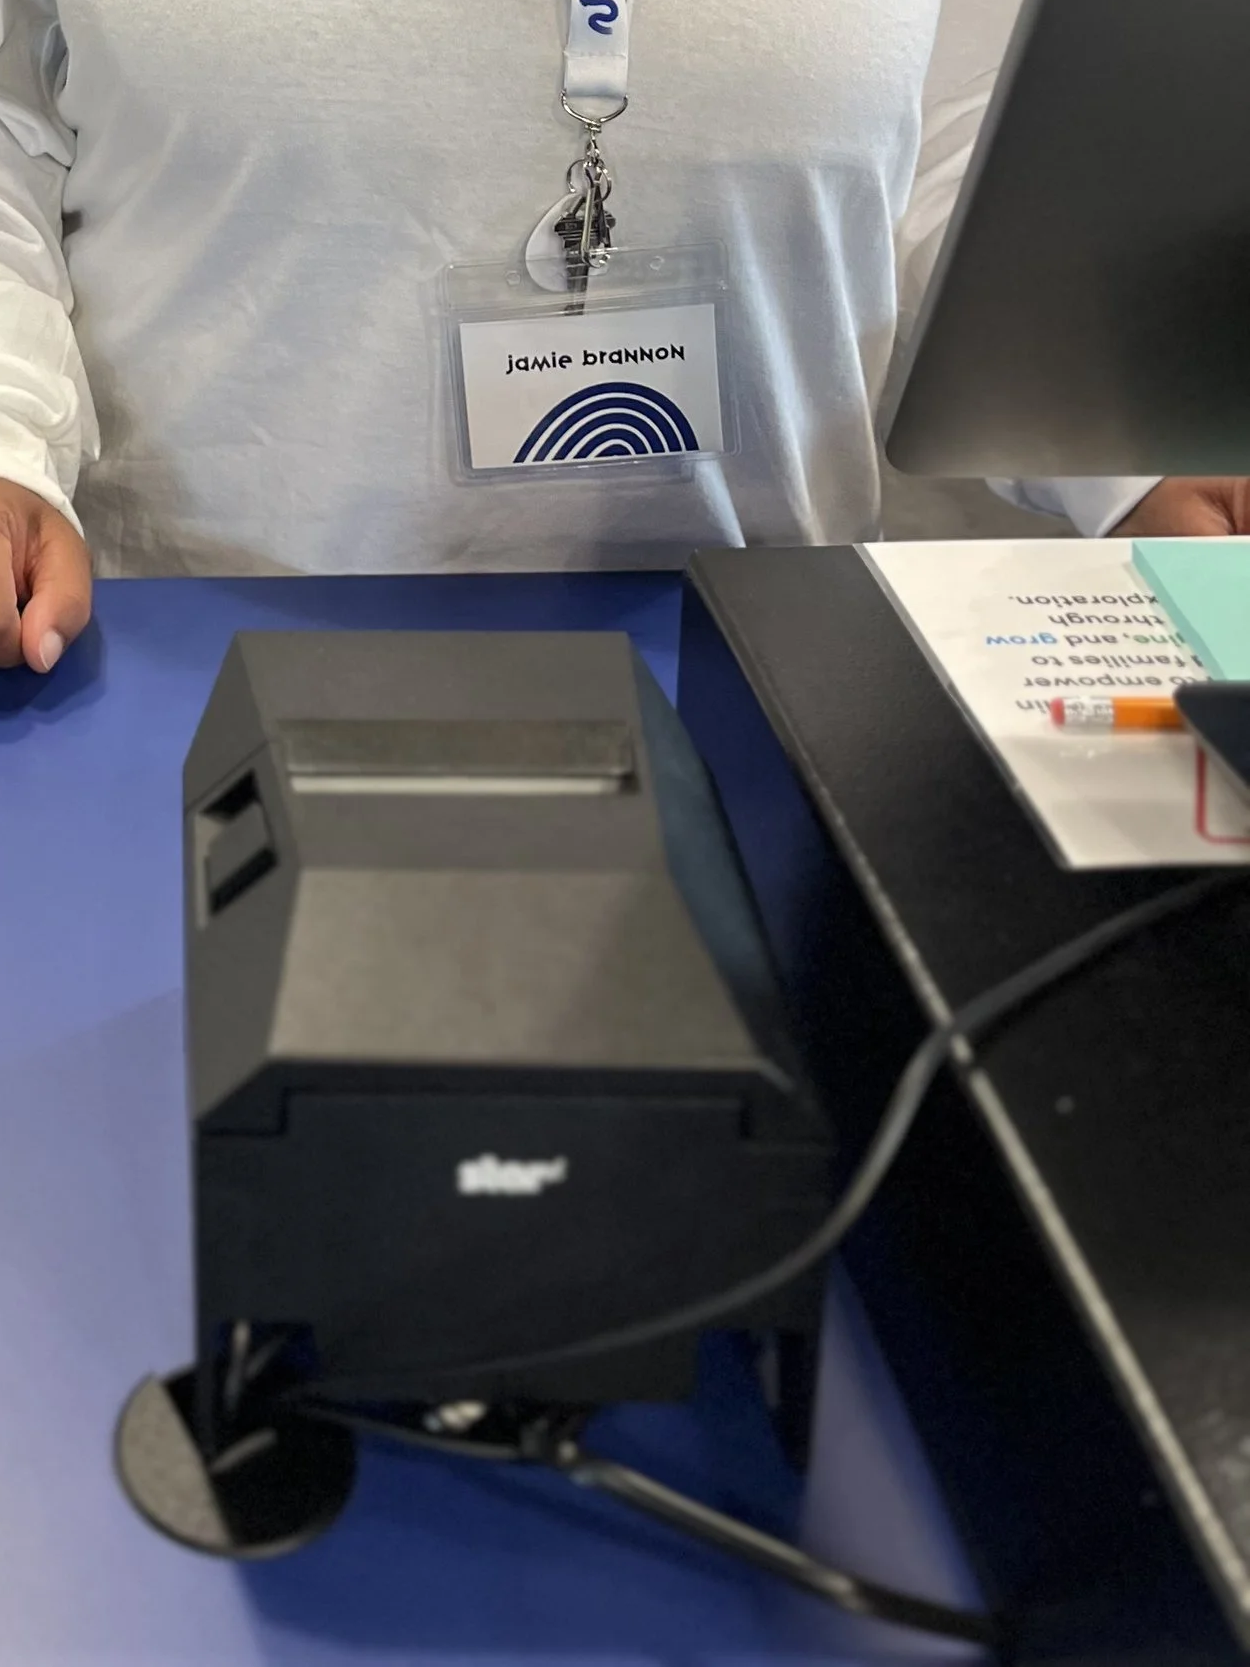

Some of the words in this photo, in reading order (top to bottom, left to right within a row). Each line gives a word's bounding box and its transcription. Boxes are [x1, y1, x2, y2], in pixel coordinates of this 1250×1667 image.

[1008, 593, 1160, 609] xploration.
[1048, 612, 1165, 627] through
[985, 632, 1058, 646] grow
[1064, 632, 1118, 647] and
[1031, 654, 1065, 667] to
[1068, 654, 1186, 670] families
[1023, 673, 1163, 688] empower
